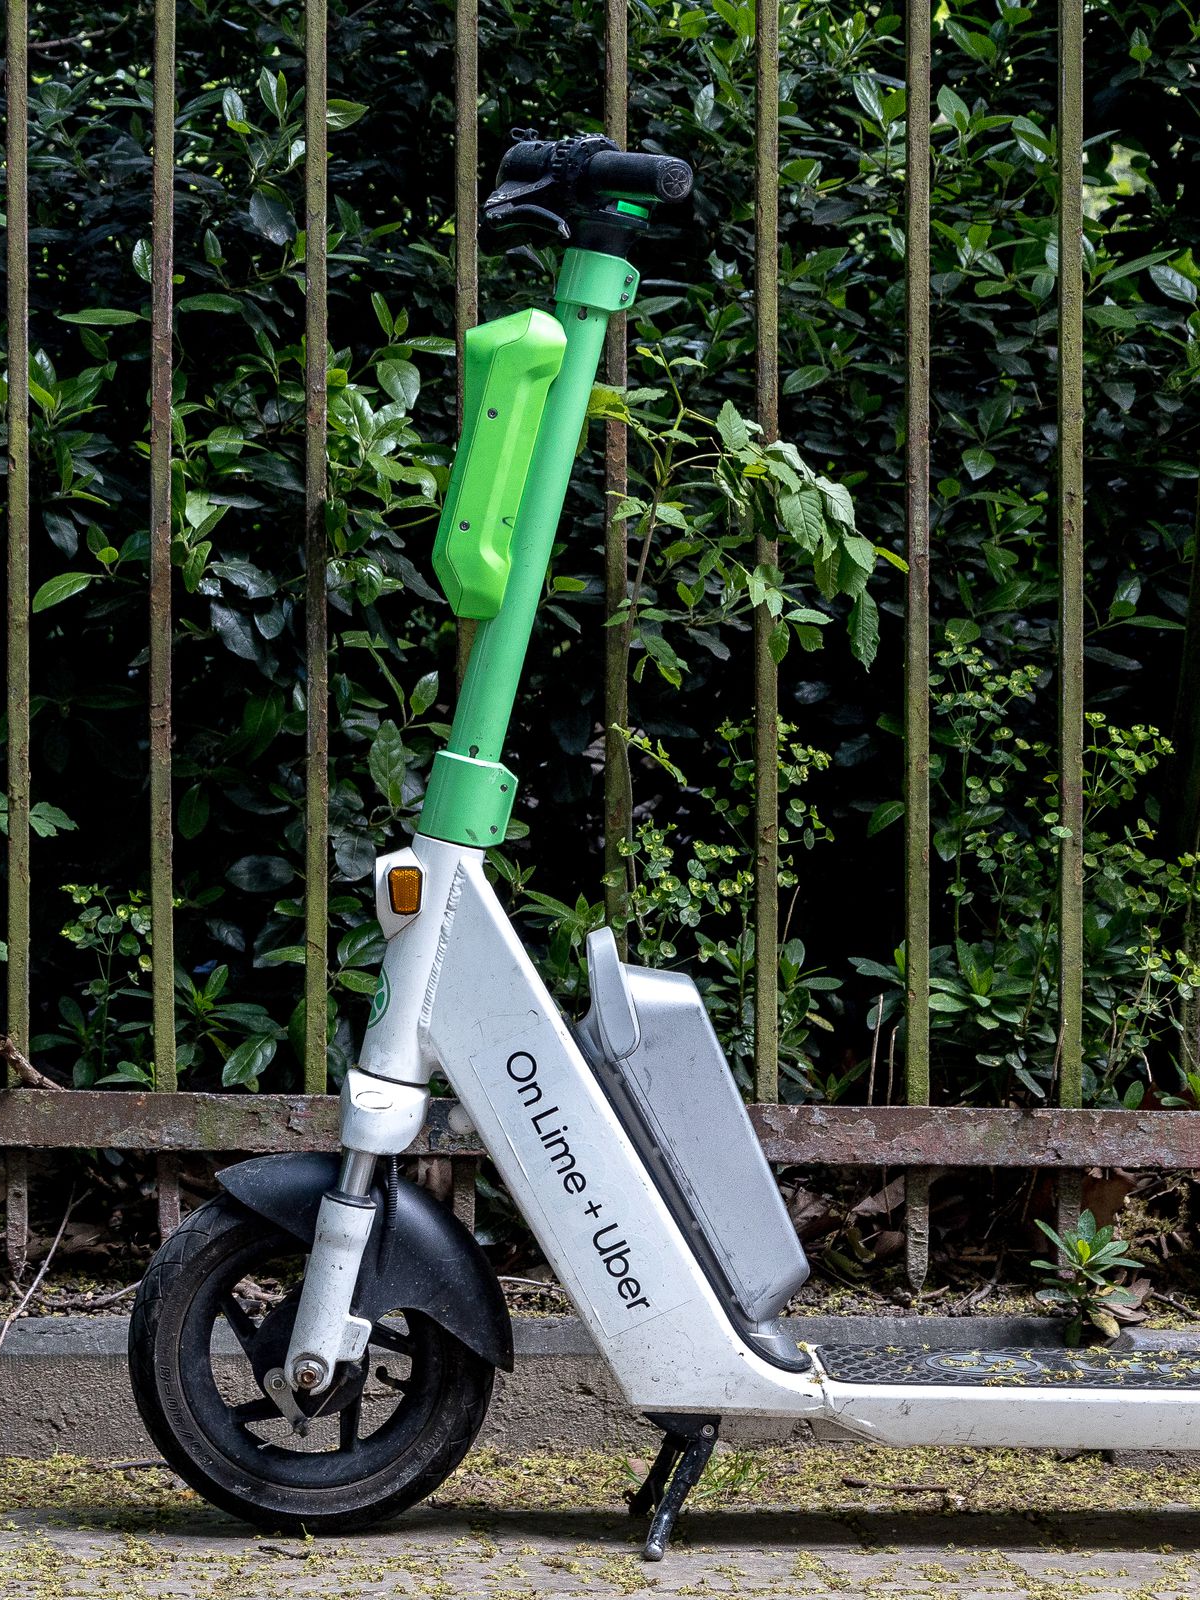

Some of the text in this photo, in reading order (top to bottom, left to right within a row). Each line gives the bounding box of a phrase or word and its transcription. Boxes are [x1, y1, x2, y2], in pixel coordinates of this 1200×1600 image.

[506, 1051, 651, 1310] On Lime + Uber
